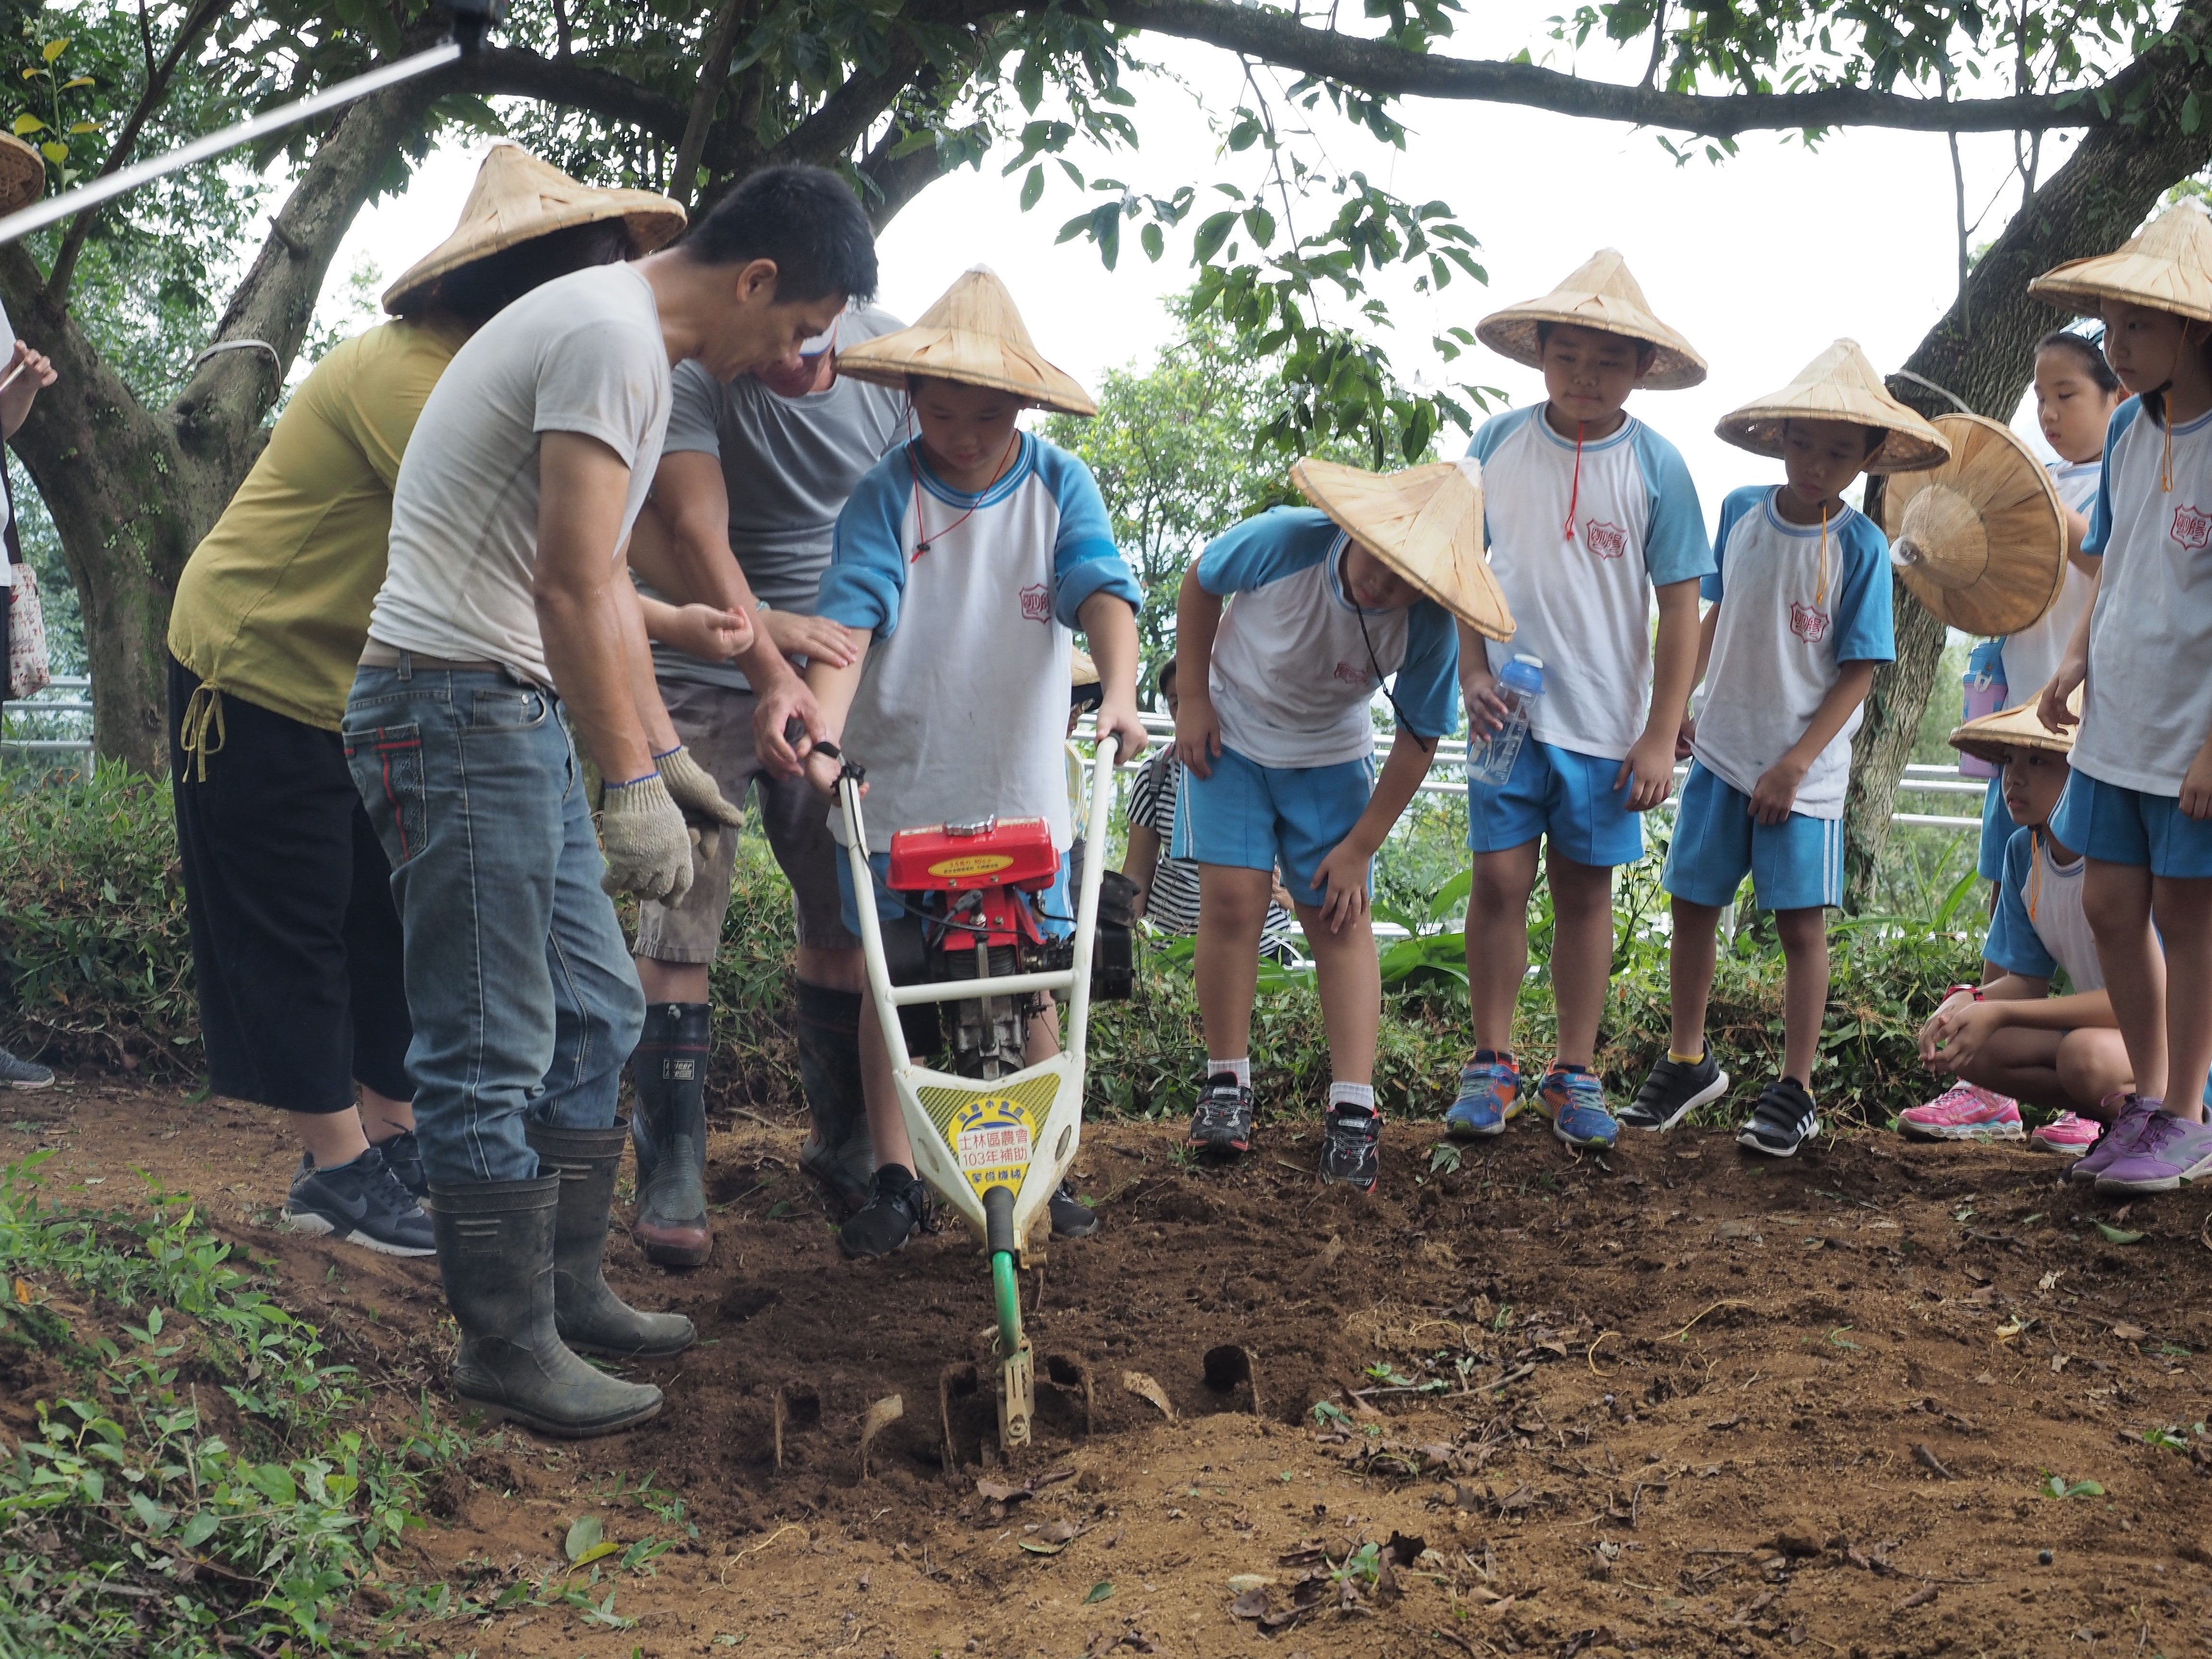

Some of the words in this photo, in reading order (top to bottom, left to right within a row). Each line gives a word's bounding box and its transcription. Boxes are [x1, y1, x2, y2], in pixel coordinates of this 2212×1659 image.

[958, 1129, 1028, 1151] 士林區農會
[962, 1146, 1027, 1167] 103年補助
